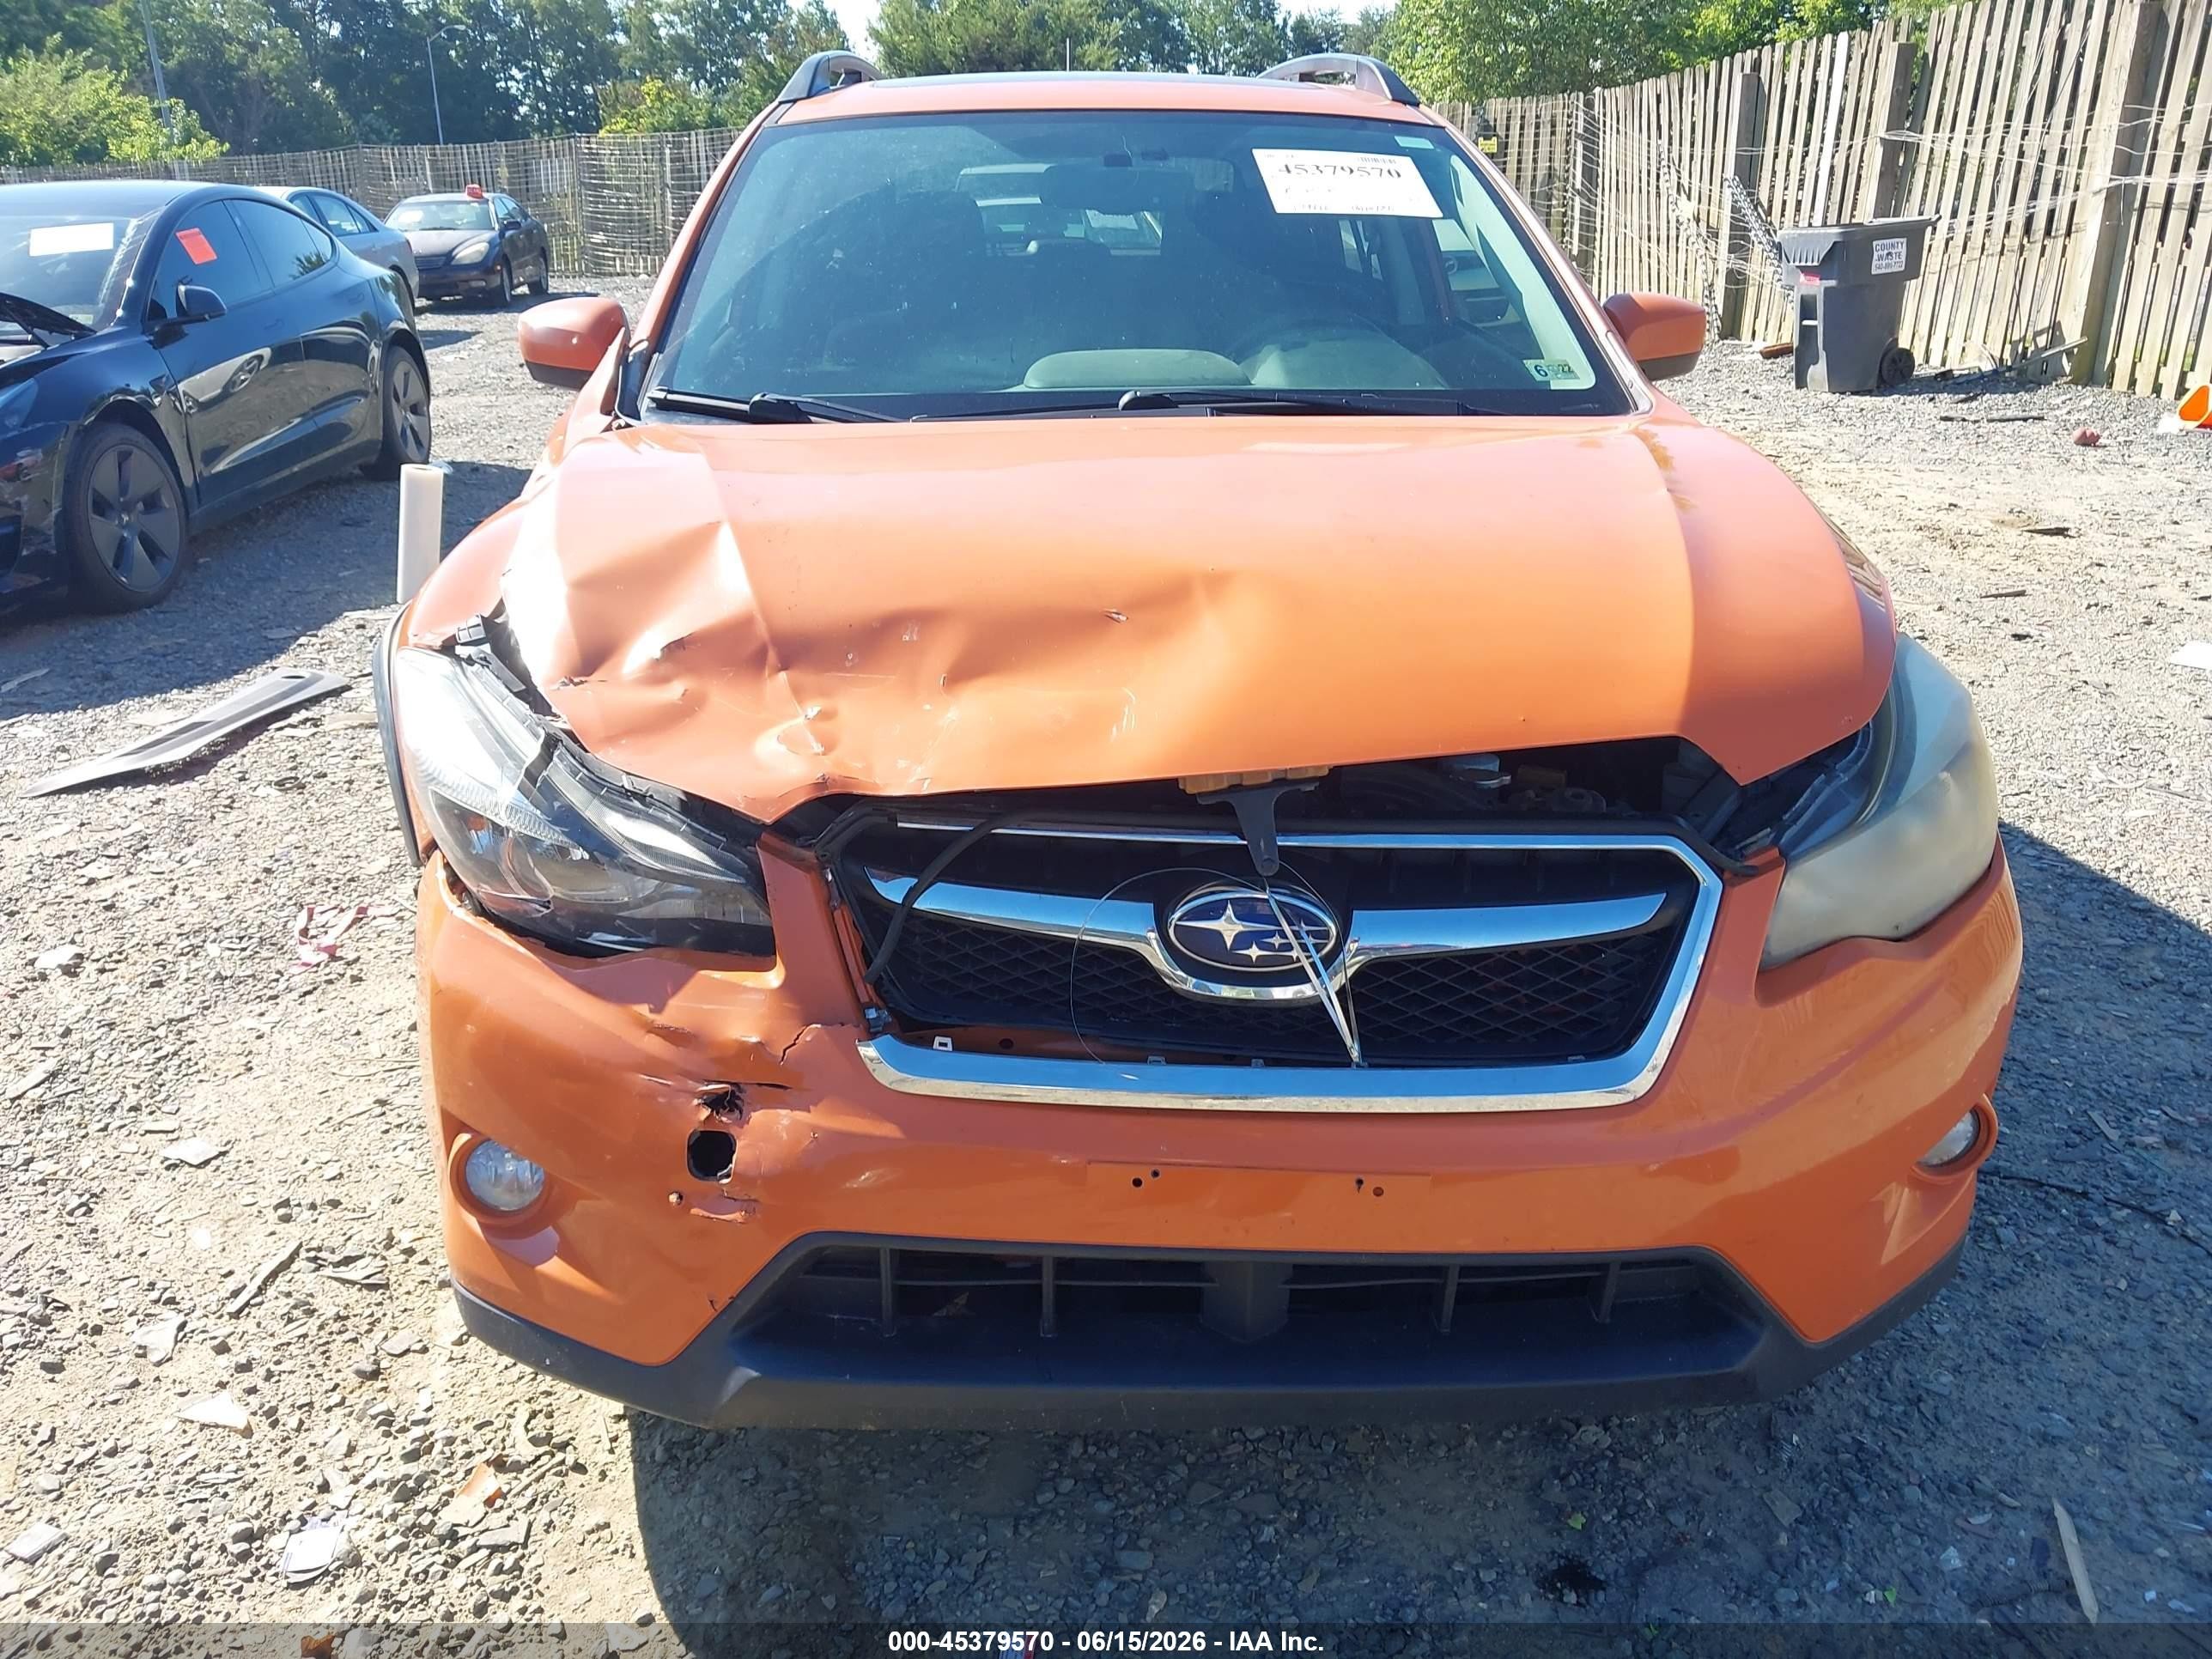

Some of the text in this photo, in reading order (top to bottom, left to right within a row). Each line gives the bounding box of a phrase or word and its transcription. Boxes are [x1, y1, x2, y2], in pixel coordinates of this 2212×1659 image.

[1278, 163, 1401, 179] 45379570
[1875, 240, 1905, 252] COUNTY
[1877, 251, 1903, 262] WASTE
[1534, 363, 1575, 377] 6 22
